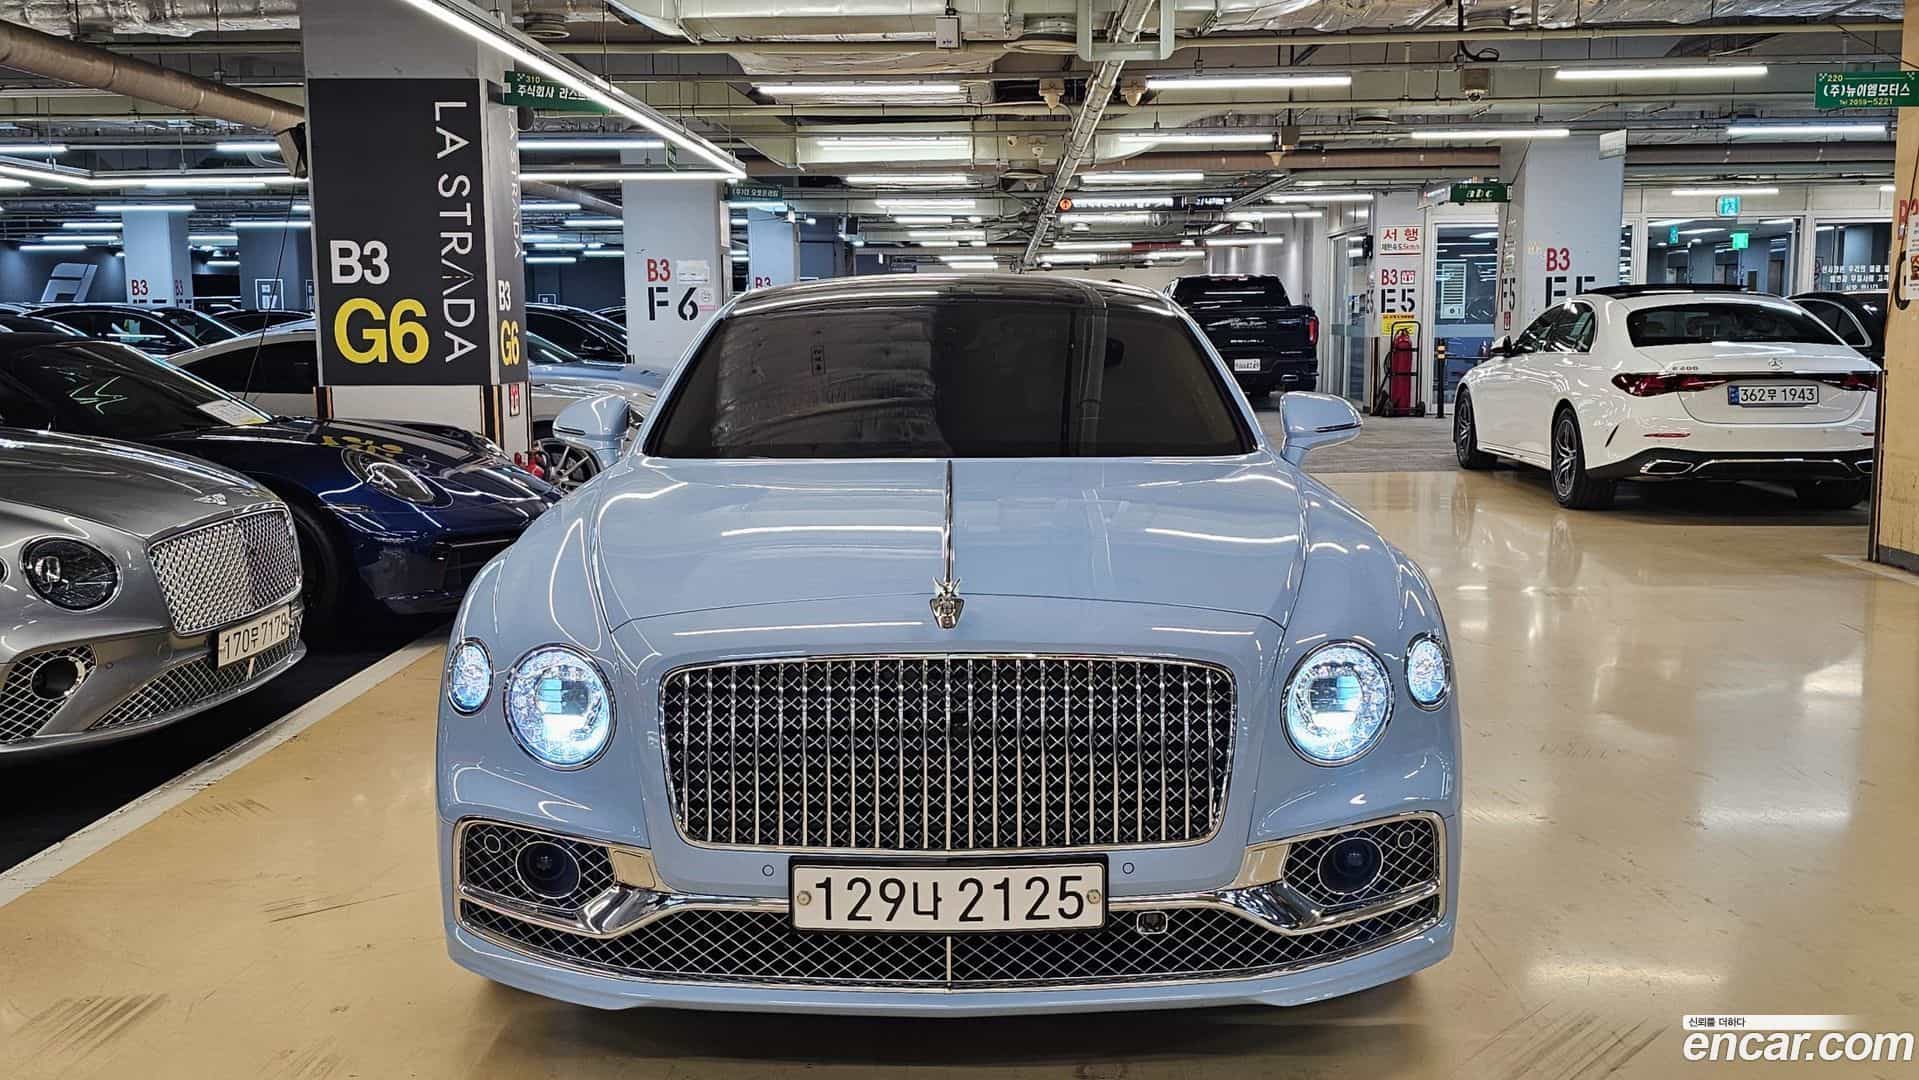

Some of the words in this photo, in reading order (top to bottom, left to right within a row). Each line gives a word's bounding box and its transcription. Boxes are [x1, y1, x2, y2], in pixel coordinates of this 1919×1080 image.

[1827, 74, 1843, 82] 220
[517, 84, 555, 99] 주식회사
[434, 100, 470, 160] LA
[1466, 188, 1494, 199] abc
[329, 239, 391, 285] B3
[438, 173, 478, 363] STRADA
[646, 258, 671, 282] B3
[1545, 247, 1571, 272] B3
[131, 279, 149, 296] B3
[755, 276, 772, 289] B3
[1381, 268, 1398, 286] B3
[497, 279, 511, 312] B3
[333, 296, 430, 365] G6
[500, 319, 521, 367] G6
[1740, 387, 1777, 402] 362무
[1782, 387, 1816, 401] 1943
[224, 627, 259, 660] 170무
[262, 615, 286, 645] 7178
[815, 875, 943, 922] 129나
[958, 875, 1085, 922] 2125
